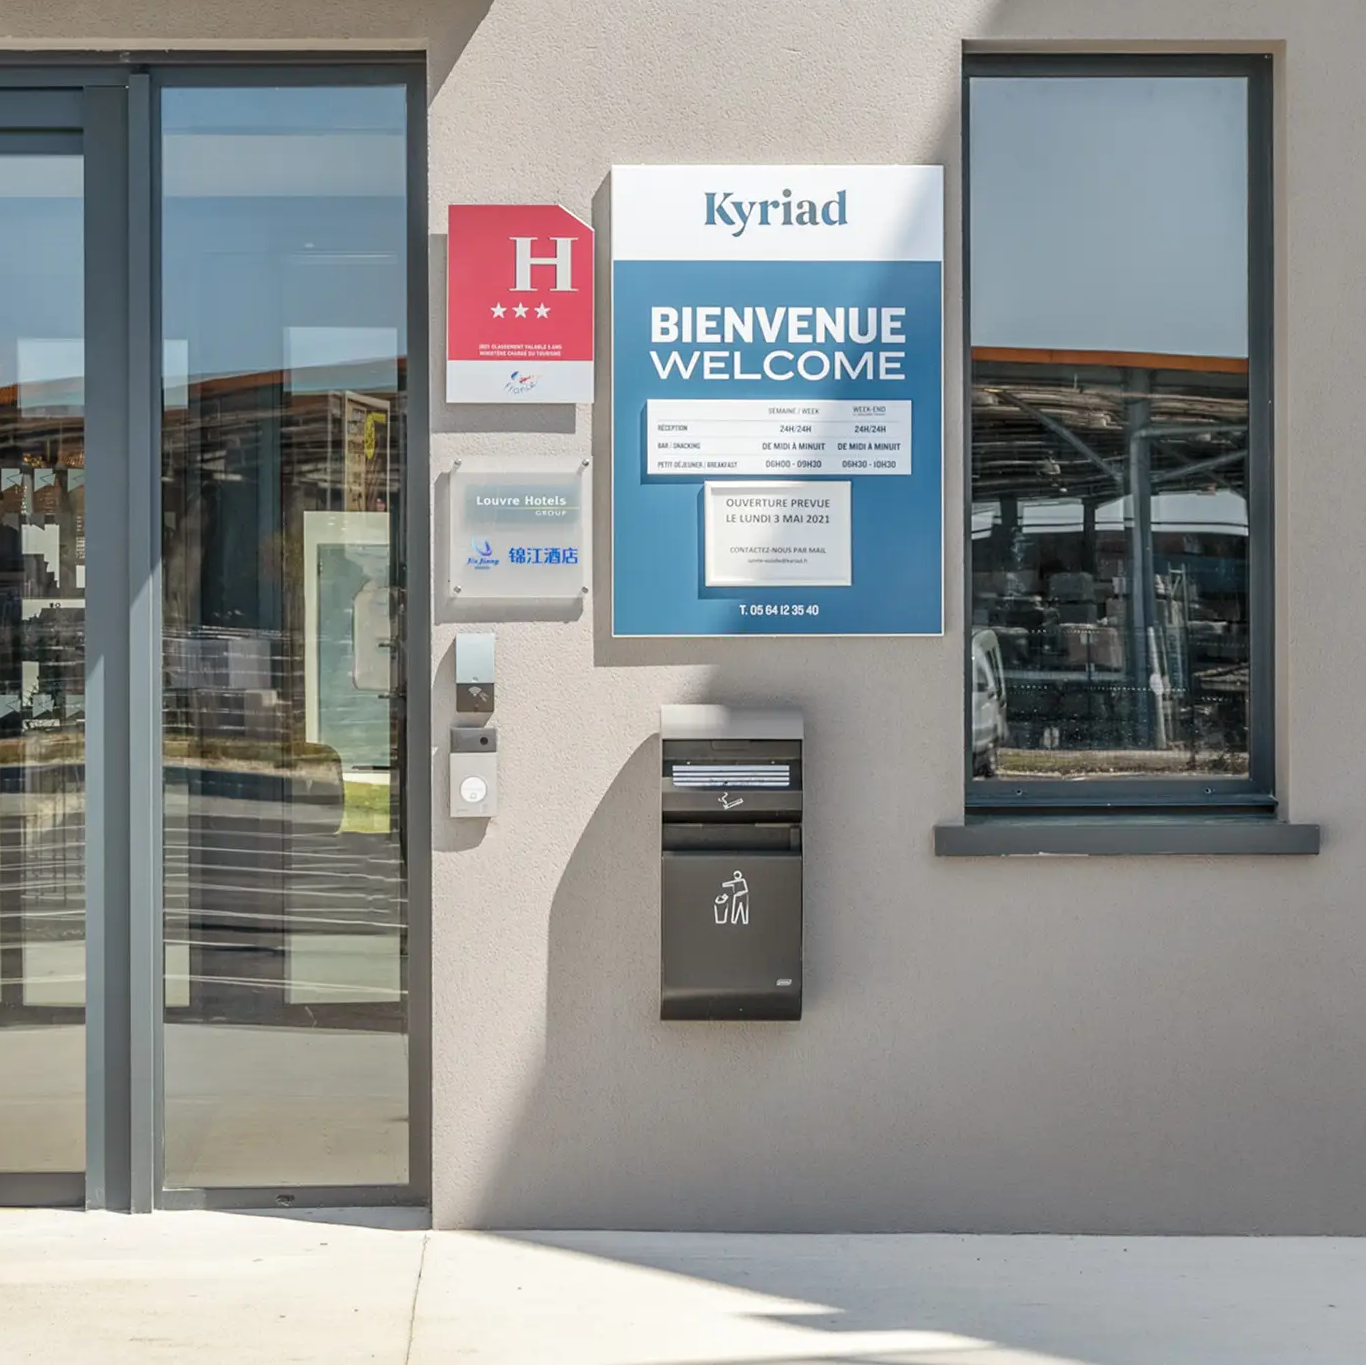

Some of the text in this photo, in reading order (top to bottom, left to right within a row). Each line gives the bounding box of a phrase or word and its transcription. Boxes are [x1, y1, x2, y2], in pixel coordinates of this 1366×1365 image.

[704, 188, 848, 237] Kyriad
[508, 236, 579, 292] H
[650, 306, 907, 344] BIENVENUE
[649, 350, 906, 381] WELCOME
[768, 407, 796, 415] SEMAINE
[801, 407, 820, 415] WEEK
[658, 424, 688, 432] RÉCEPTION
[779, 425, 812, 433] 24H/24H
[854, 425, 887, 433] 24H/24H
[765, 460, 791, 468] 06H00
[797, 460, 822, 468] 09H30
[873, 460, 897, 468] 10H30
[476, 495, 567, 506] Louvre Hotels
[726, 498, 831, 508] OUVERTURE PREVUE
[726, 514, 830, 523] LE LUNDI 3 MAI 2021
[508, 546, 579, 564] 锦江酒店
[739, 604, 819, 616] T. 05 64 12 35 40
